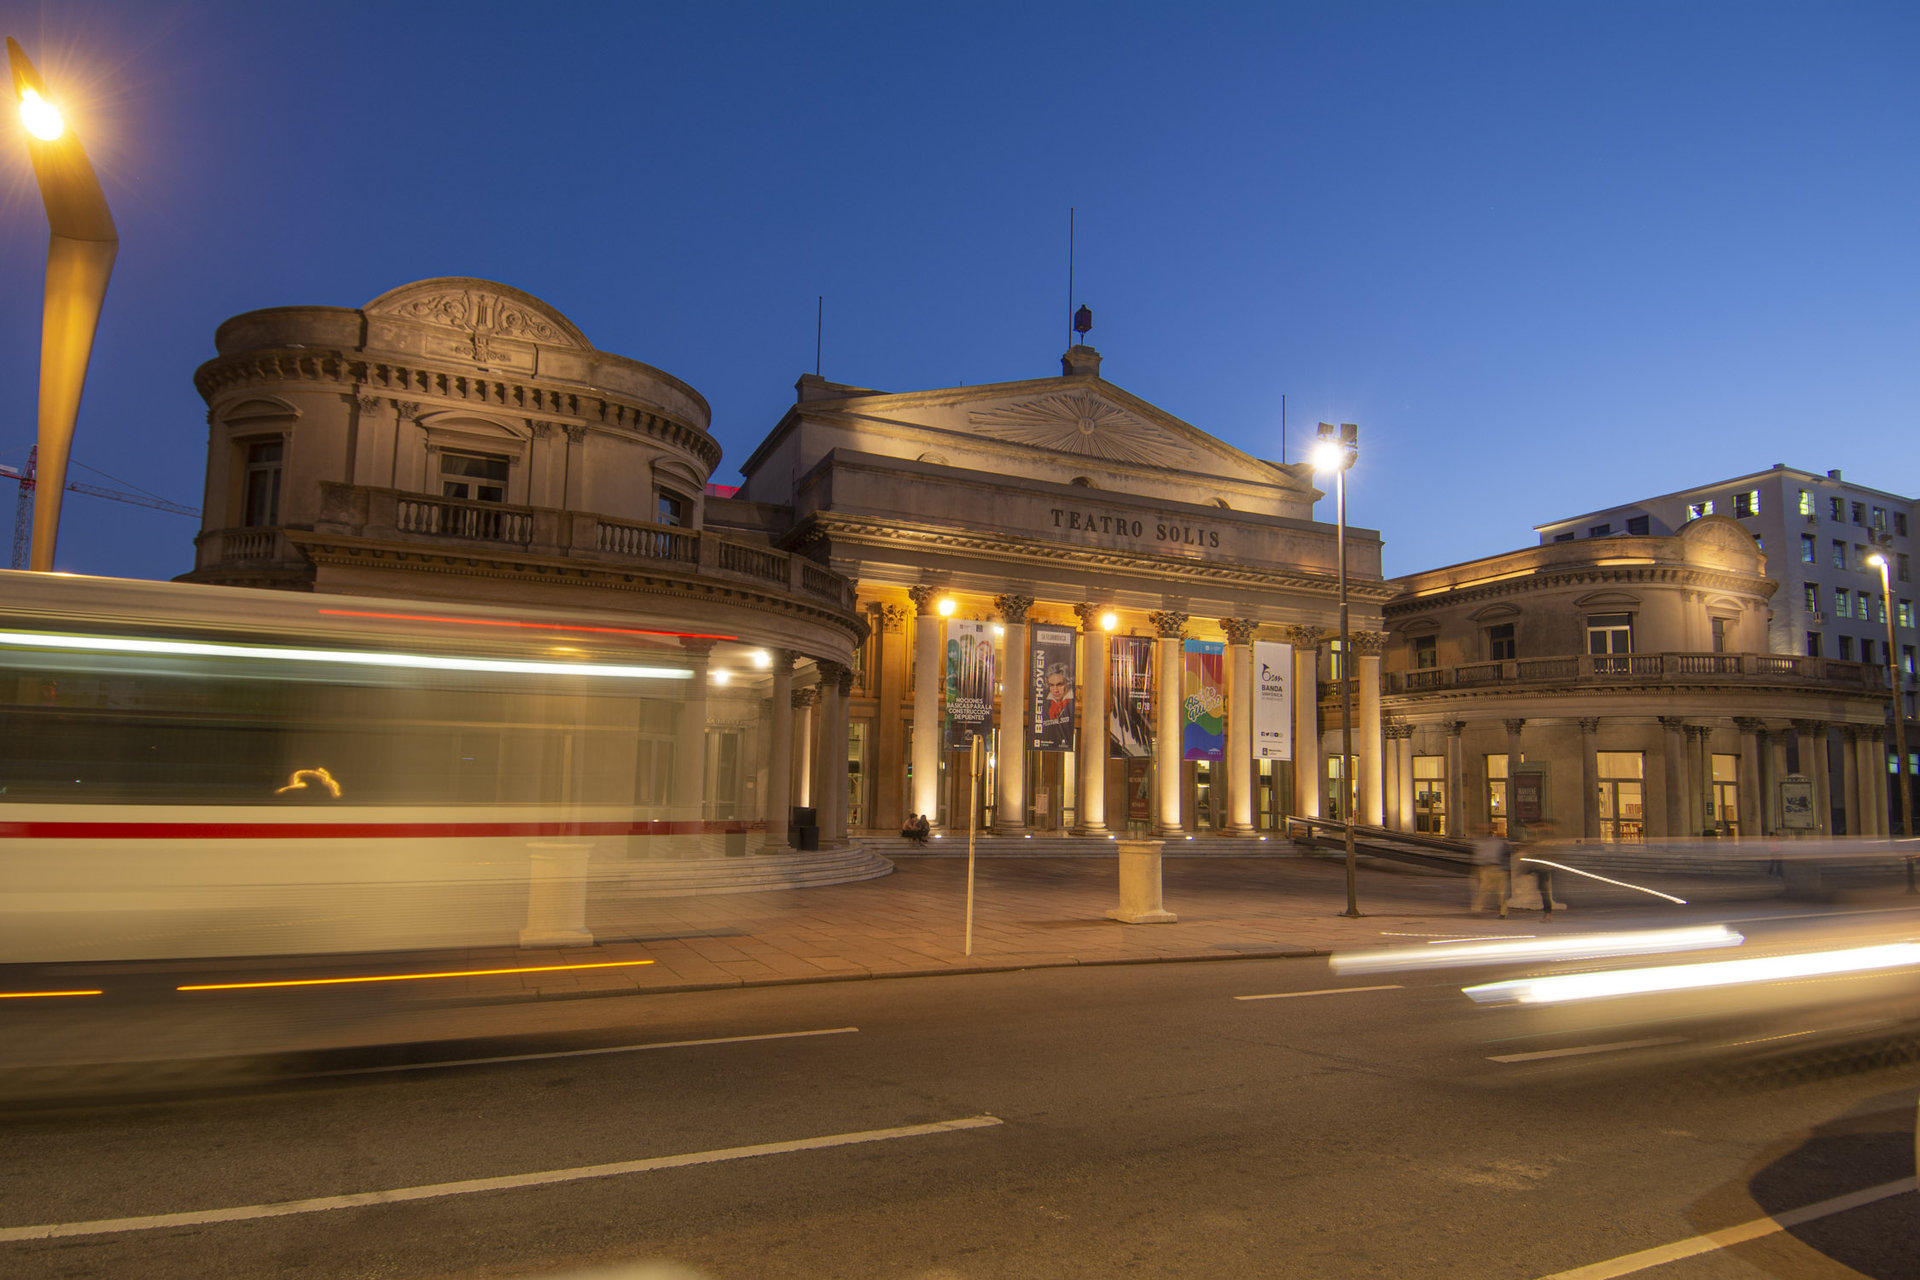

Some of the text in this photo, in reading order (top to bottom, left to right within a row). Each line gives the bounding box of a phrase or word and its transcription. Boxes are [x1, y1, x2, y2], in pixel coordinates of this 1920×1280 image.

[1051, 509, 1220, 548] TEATRO SOLIS
[1035, 650, 1045, 733] BEETHOVEN
[1261, 684, 1283, 692] BANDA
